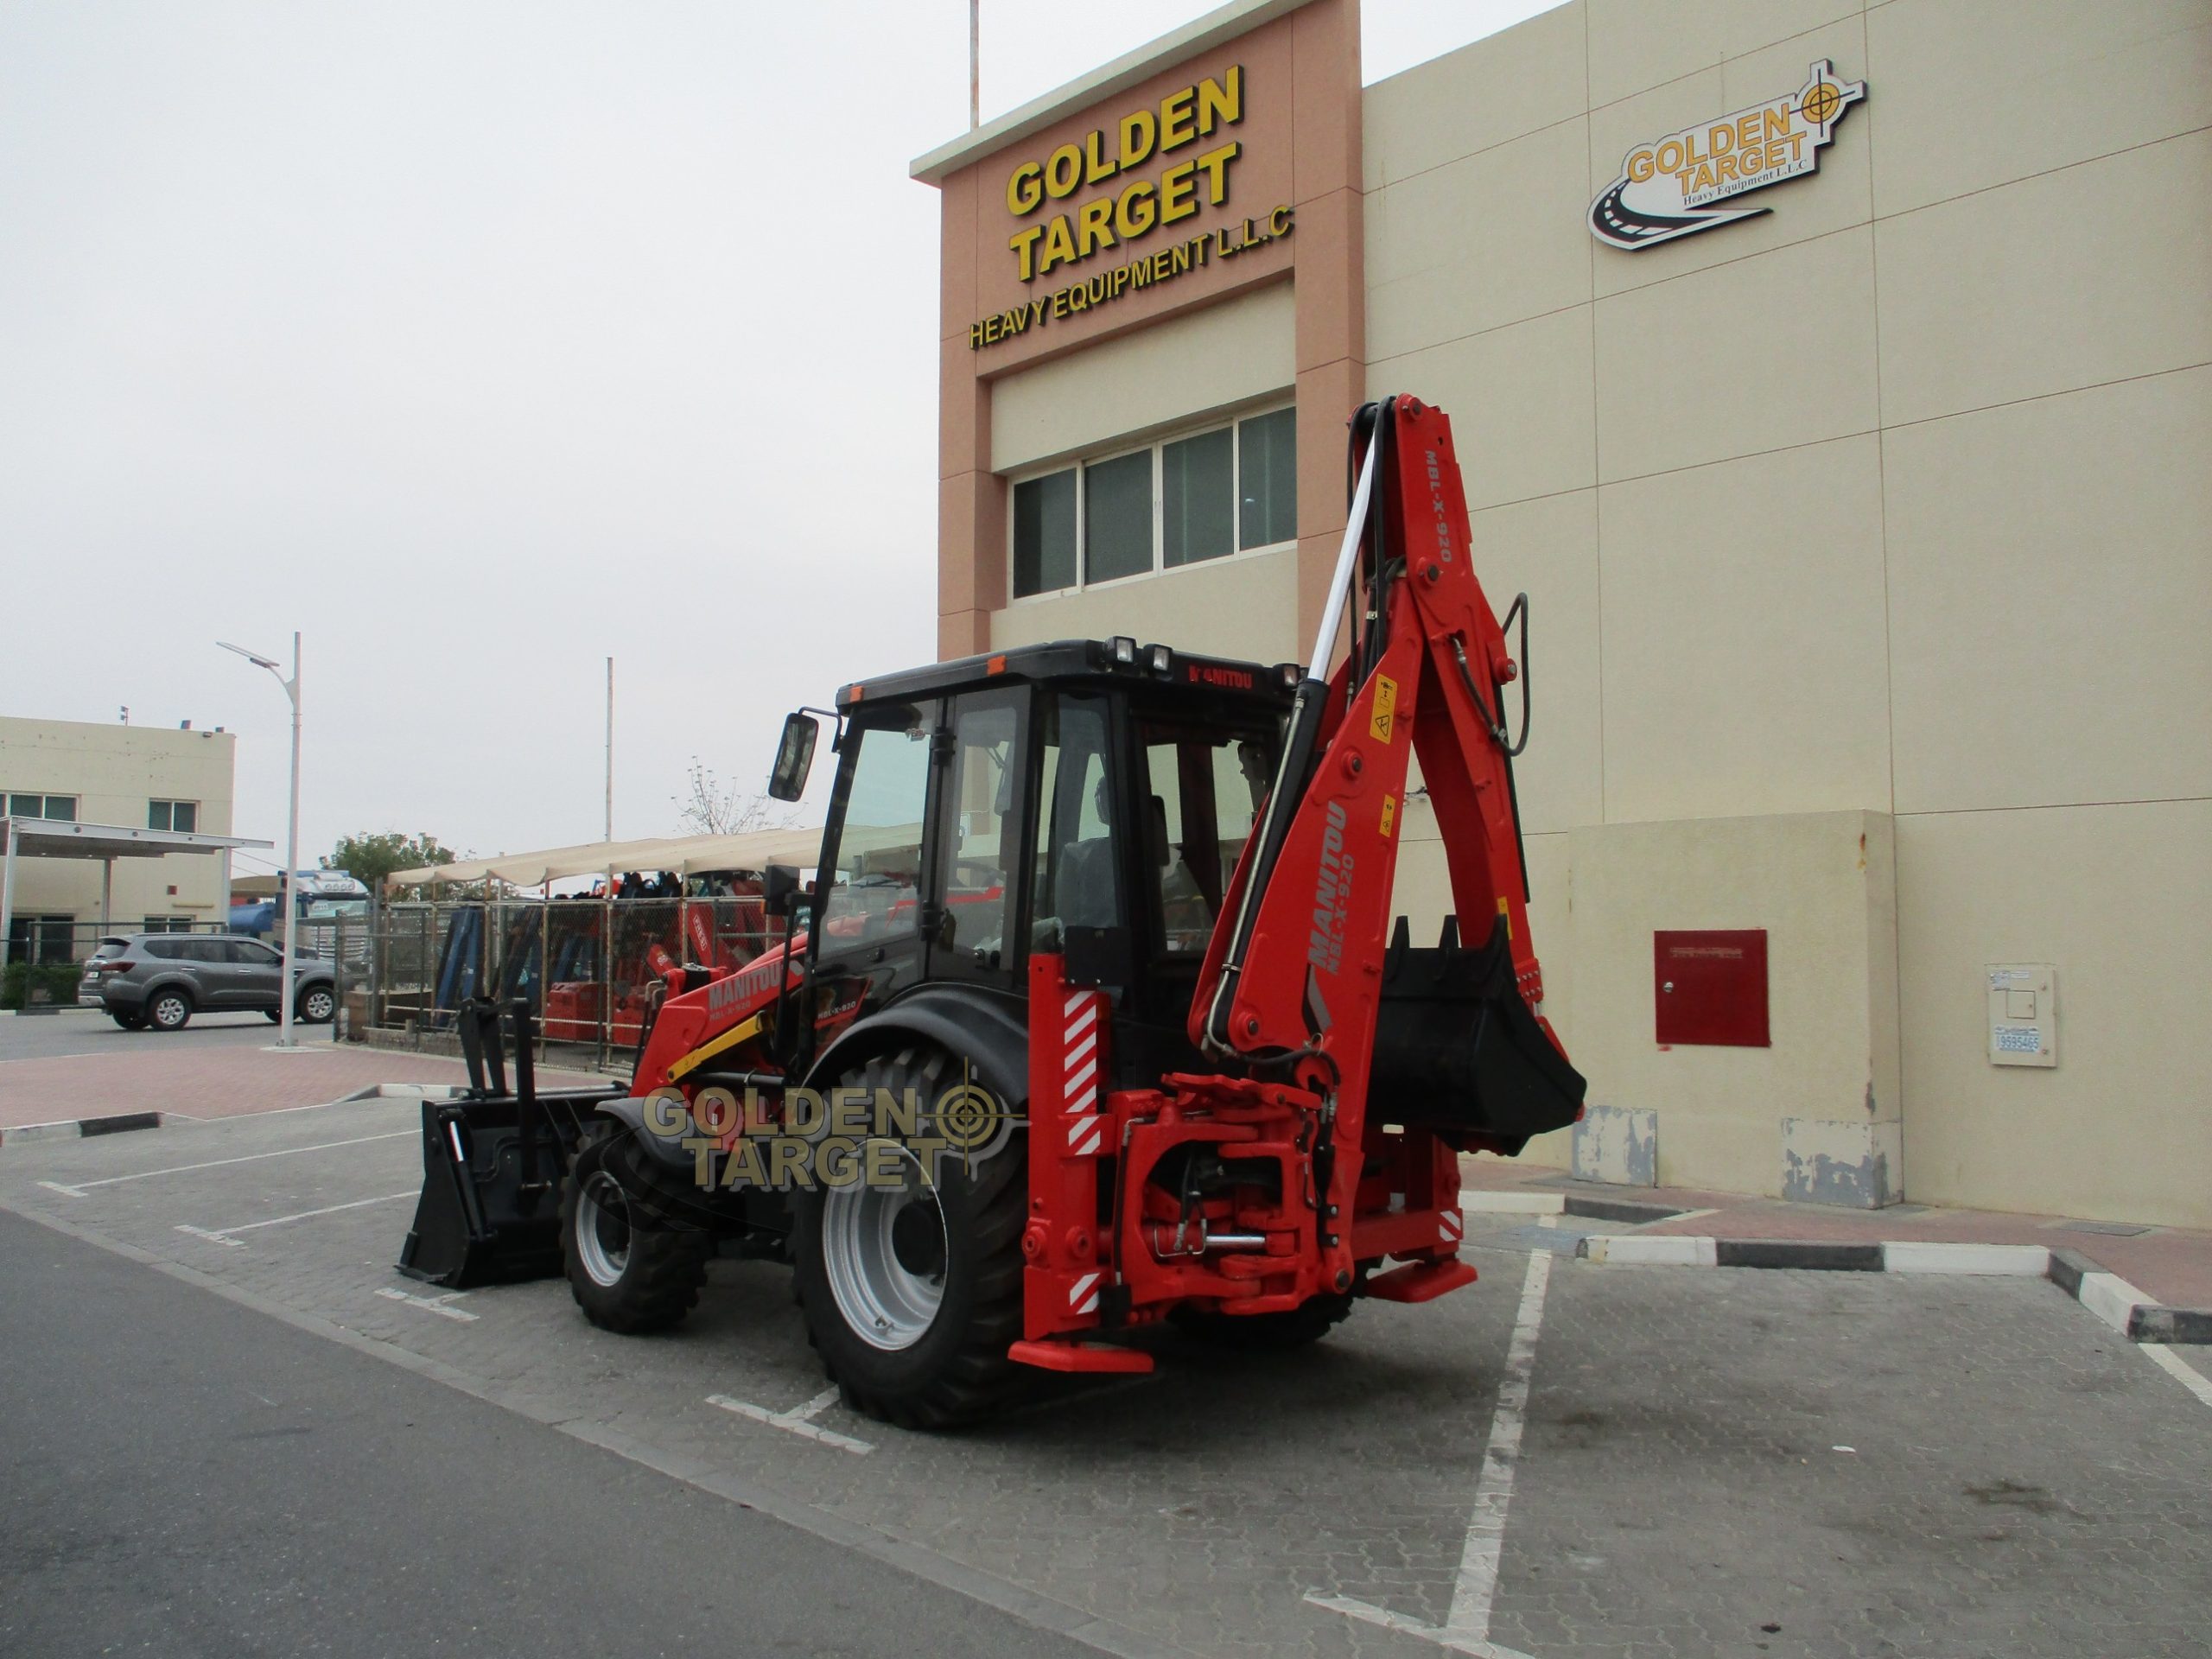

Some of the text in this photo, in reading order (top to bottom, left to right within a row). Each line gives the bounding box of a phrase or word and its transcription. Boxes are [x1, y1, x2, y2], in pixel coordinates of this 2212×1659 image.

[1007, 65, 1243, 216] GOLDEN
[1628, 103, 1789, 183] GOLDEN
[1675, 131, 1807, 196] TARGET
[1684, 191, 1714, 206] Heavy
[1718, 172, 1773, 195] Equipment
[1009, 142, 1240, 283] TARGET
[969, 205, 1294, 349] HEAVY EQUIPMENT L.L.C
[1307, 801, 1347, 970] MANITOU
[709, 961, 781, 1011] MANITOU
